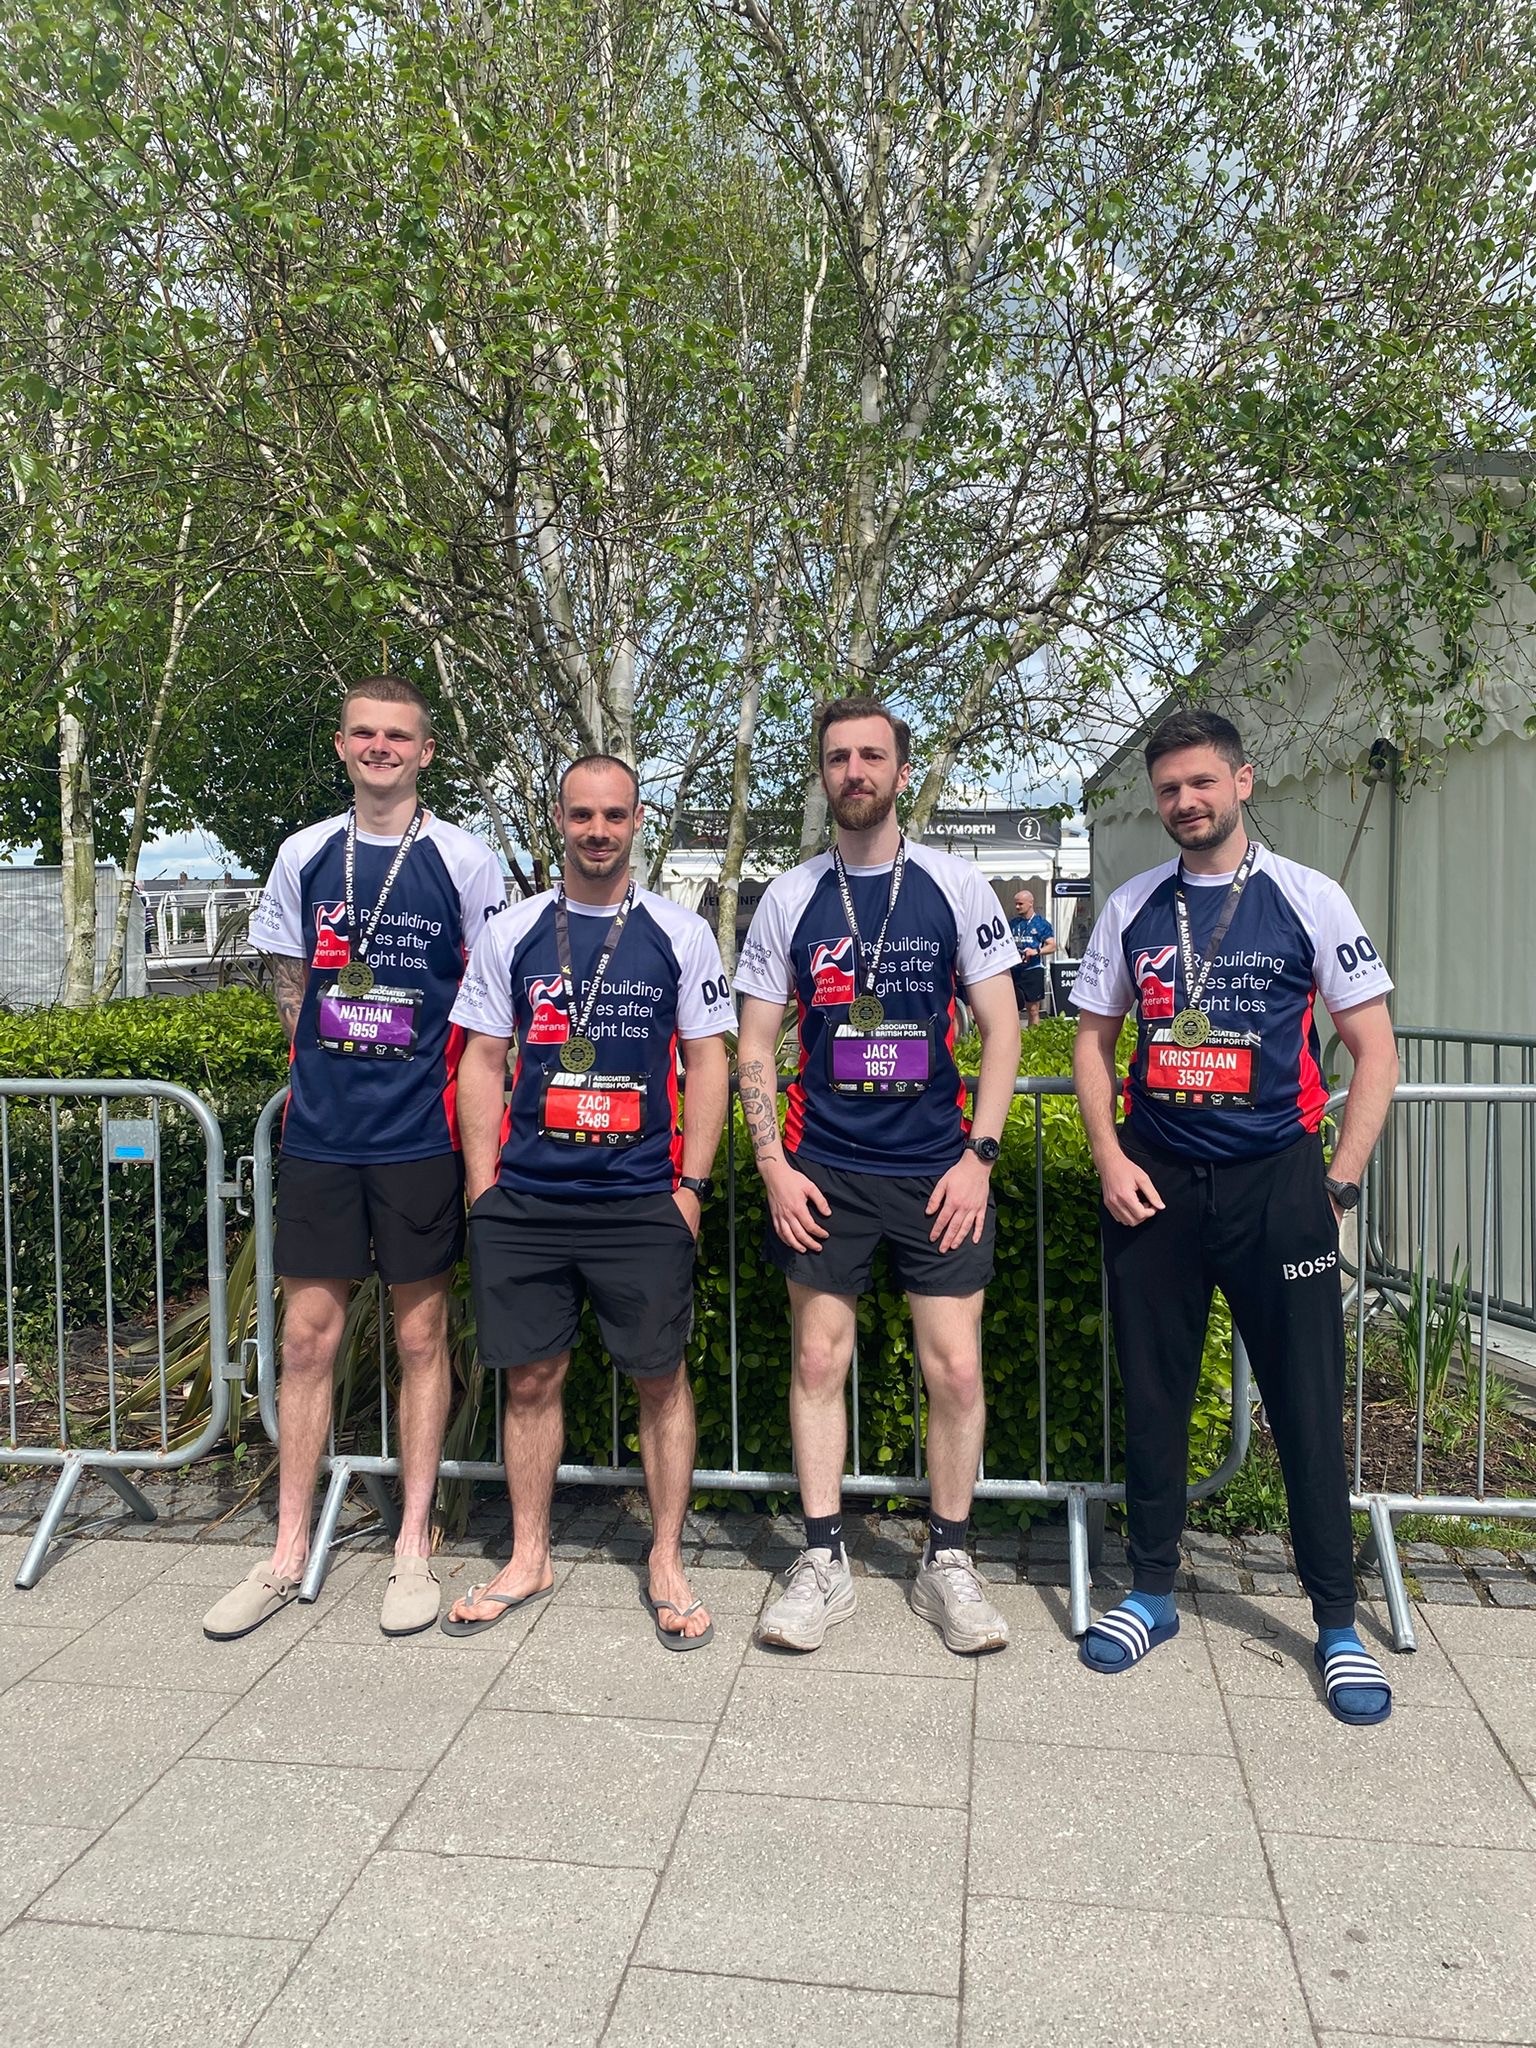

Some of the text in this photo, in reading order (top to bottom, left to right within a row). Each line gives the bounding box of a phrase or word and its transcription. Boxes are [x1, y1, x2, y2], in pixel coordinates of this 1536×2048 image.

[936, 824, 996, 834] CYMORTH
[366, 887, 390, 935] MARATHON
[384, 836, 413, 887] CASNEWYDD
[360, 909, 442, 936] Rbuilding
[1179, 920, 1194, 970] MARATHON
[366, 951, 397, 968] ight
[1198, 961, 1212, 984] 2026
[1349, 969, 1368, 982] FOR
[581, 980, 663, 1002] Rbuilding
[875, 977, 934, 997] ght loss
[1231, 973, 1273, 991] after
[390, 996, 414, 1005] PORTS
[579, 976, 601, 1026] MARATHON
[1199, 995, 1266, 1015] ght loss
[340, 1005, 393, 1024] NATHAN
[348, 1022, 378, 1039] 1959
[587, 1022, 617, 1041] ight
[621, 1022, 649, 1038] loss
[1223, 1038, 1250, 1046] PORTS
[862, 1044, 898, 1059] JACK
[1159, 1050, 1237, 1070] KRISTIAAN
[865, 1061, 896, 1077] 1857
[1177, 1069, 1214, 1087] 3597
[550, 1072, 587, 1087] ABP
[577, 1094, 611, 1111] ZACH
[576, 1111, 610, 1128] 3489
[1282, 1250, 1337, 1280] BOSS
